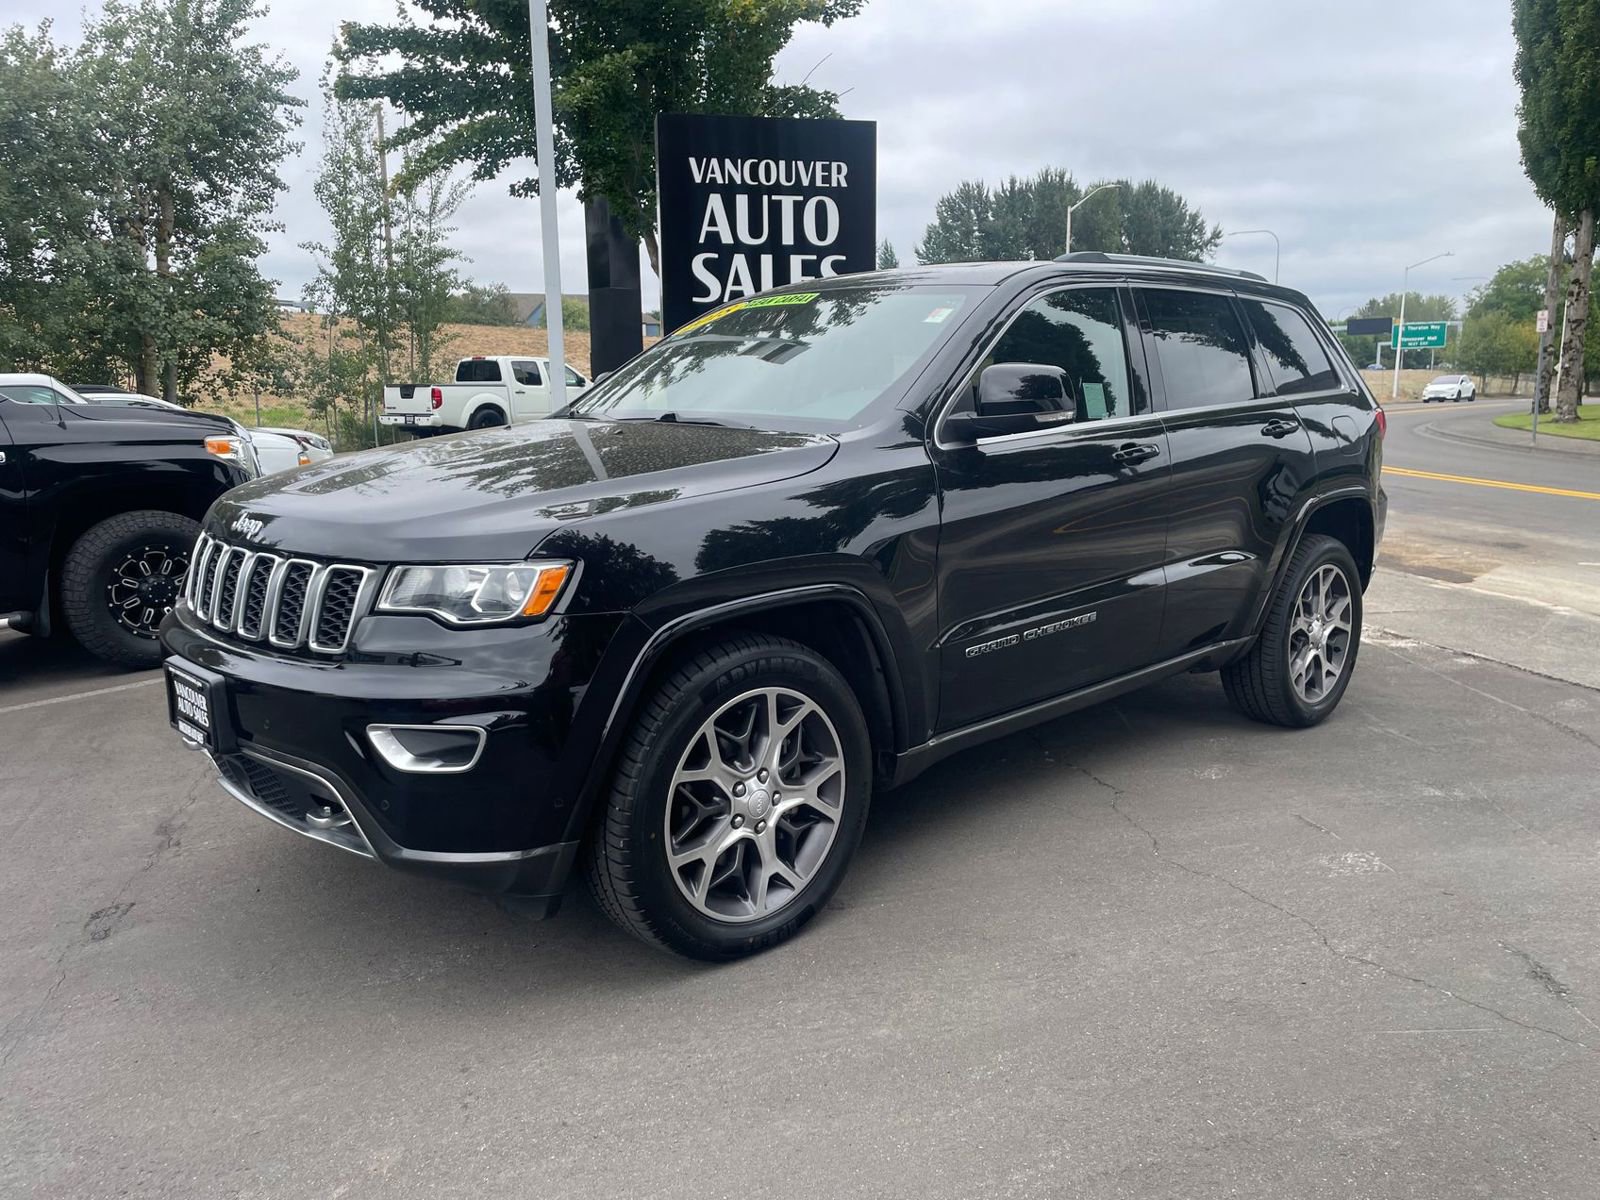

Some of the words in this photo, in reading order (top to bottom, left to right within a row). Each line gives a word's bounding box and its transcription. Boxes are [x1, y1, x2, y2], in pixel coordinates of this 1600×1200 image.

[688, 157, 848, 188] VANCOUVER
[698, 193, 840, 247] AUTO
[231, 512, 263, 540] Jeep
[965, 633, 1020, 658] GRAND
[1023, 611, 1097, 640] CHEROKEE
